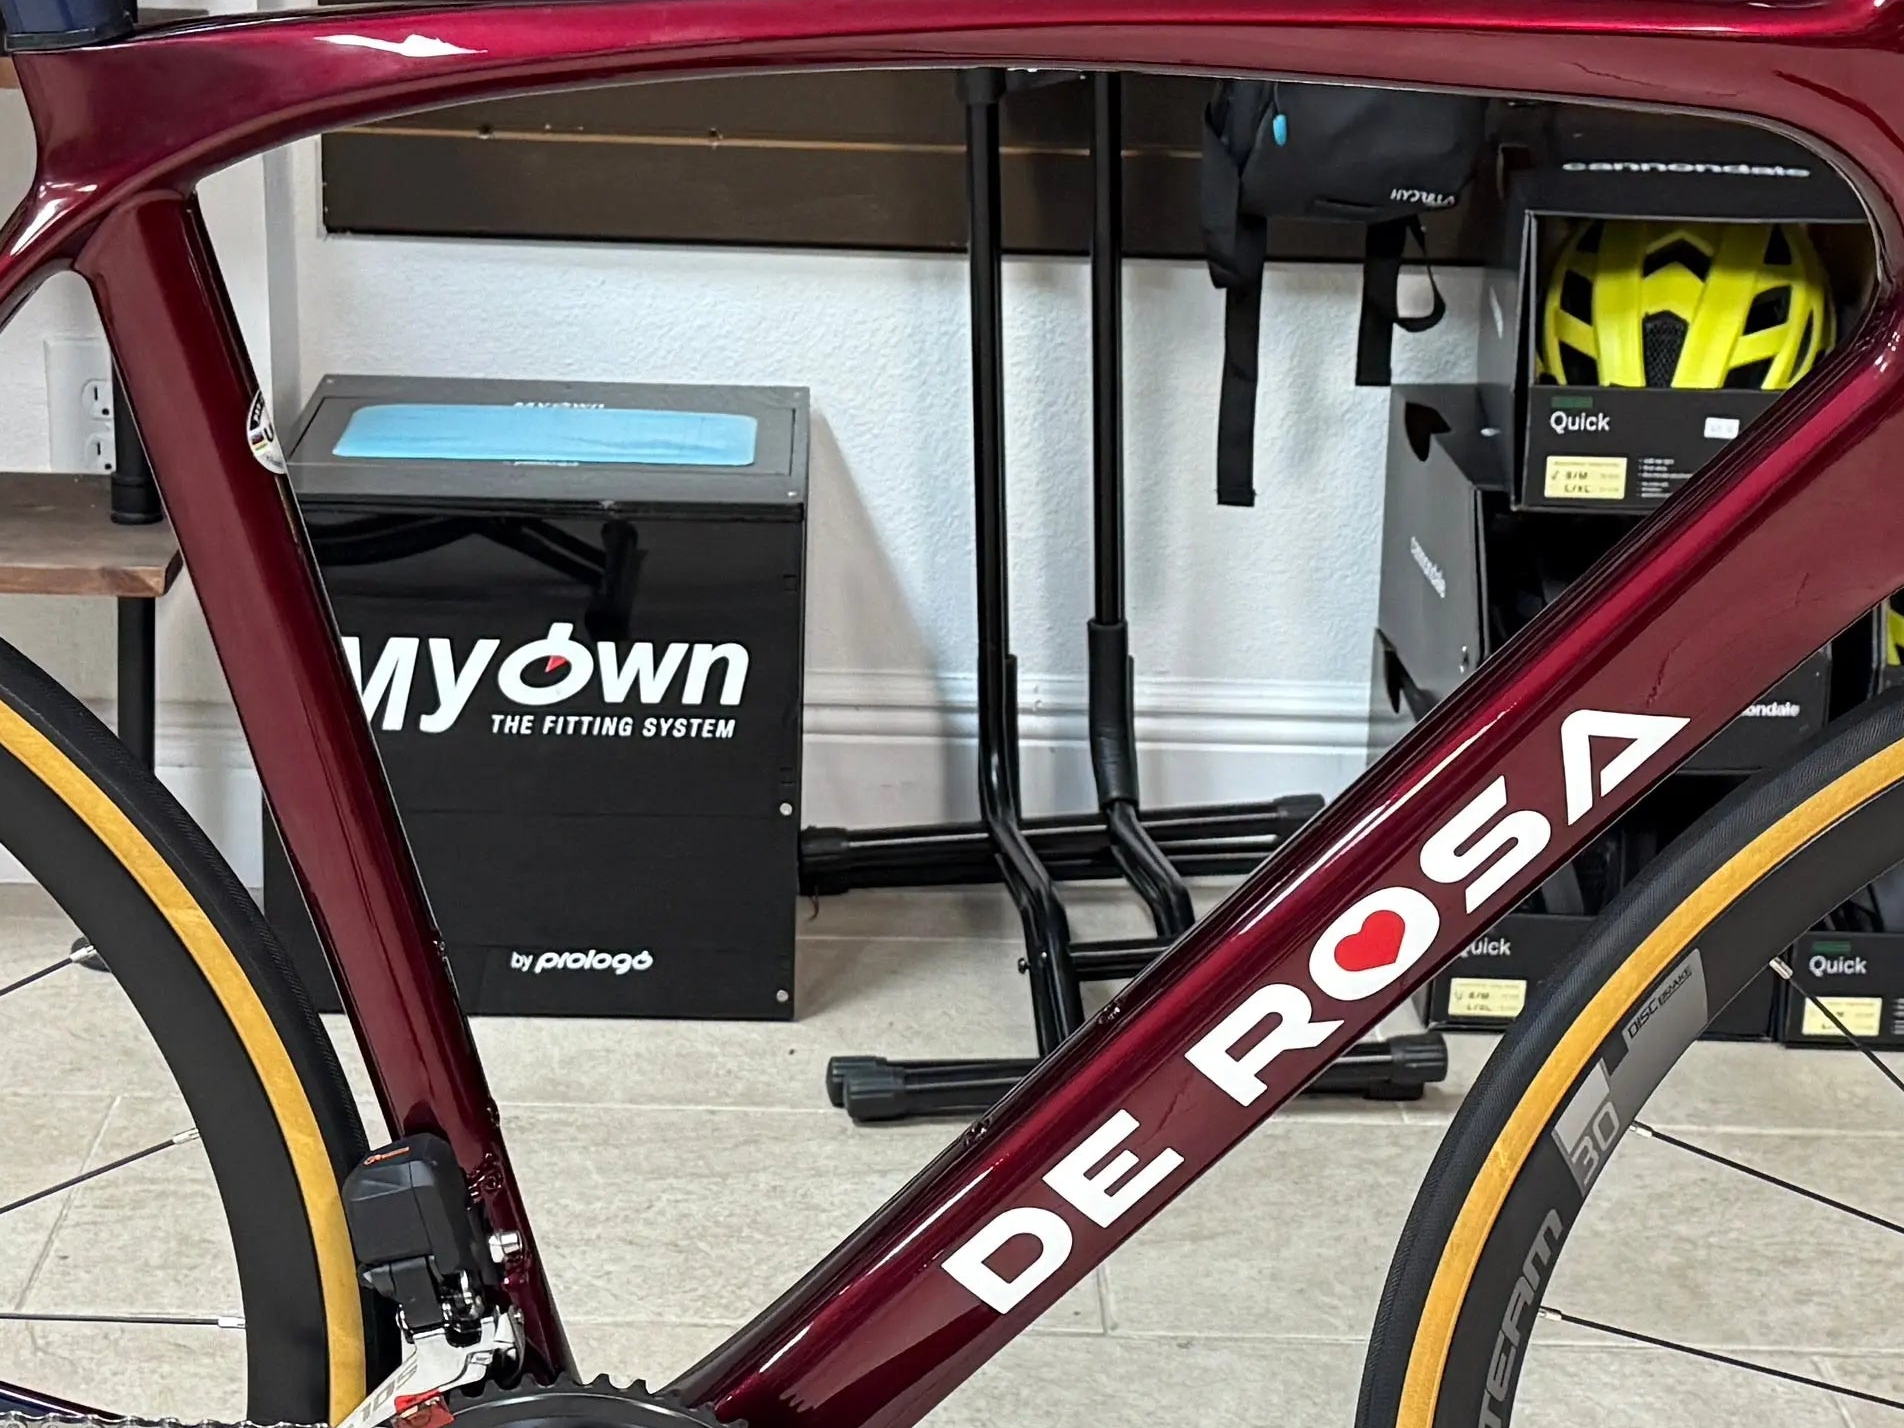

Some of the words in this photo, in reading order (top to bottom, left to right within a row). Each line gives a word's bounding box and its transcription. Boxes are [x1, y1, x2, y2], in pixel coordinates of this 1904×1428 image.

[1550, 412, 1610, 433] Quick
[491, 714, 534, 735] THE
[542, 716, 633, 737] FITTING
[642, 717, 735, 738] SYSTEM
[1460, 937, 1511, 957] uick
[510, 951, 533, 972] by
[534, 949, 654, 974] prologo
[1809, 956, 1867, 976] Quick
[942, 1113, 1184, 1315] DE
[1185, 709, 1691, 1107] ROSA
[1627, 999, 1660, 1039] DISC
[1575, 1110, 1621, 1186] 30
